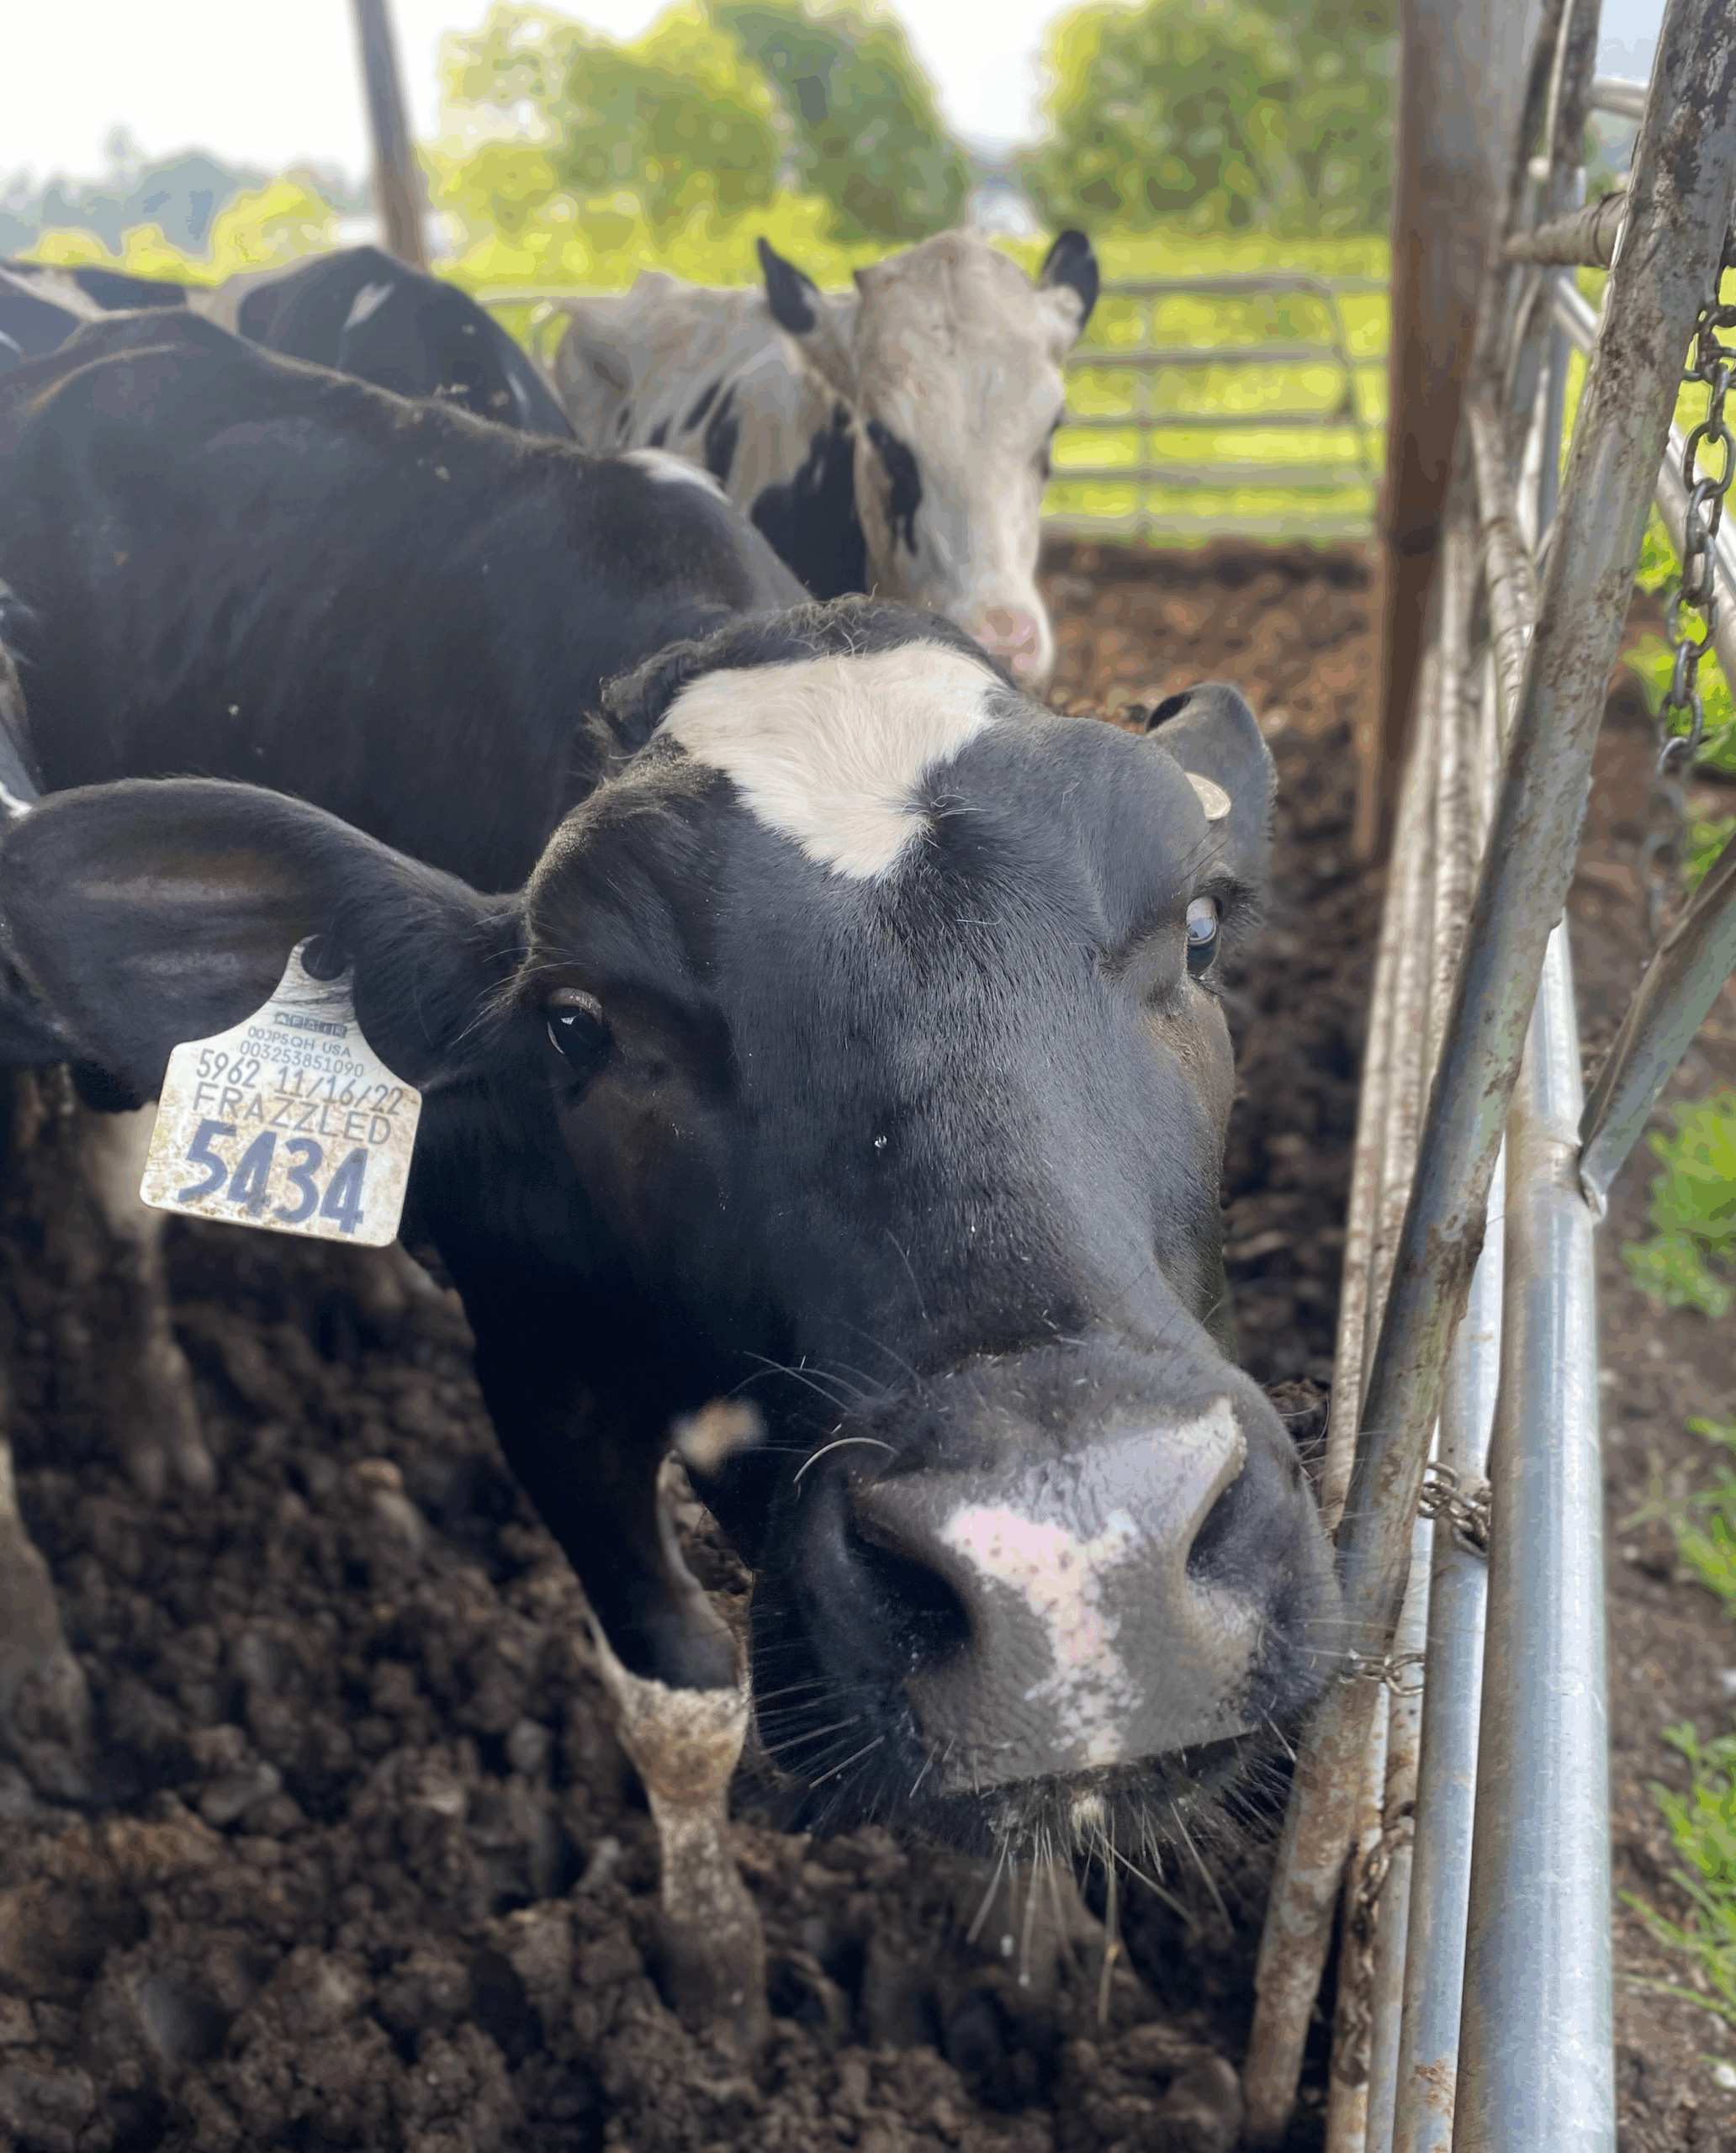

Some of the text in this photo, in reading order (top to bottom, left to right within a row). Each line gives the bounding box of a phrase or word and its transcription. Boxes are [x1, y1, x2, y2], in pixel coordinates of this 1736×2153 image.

[196, 1048, 404, 1115] 5962 11/16/22
[240, 1040, 364, 1077] 003253851090
[323, 1041, 351, 1058] USA
[192, 1081, 391, 1145] FRAZZLED
[177, 1119, 368, 1234] 5434
